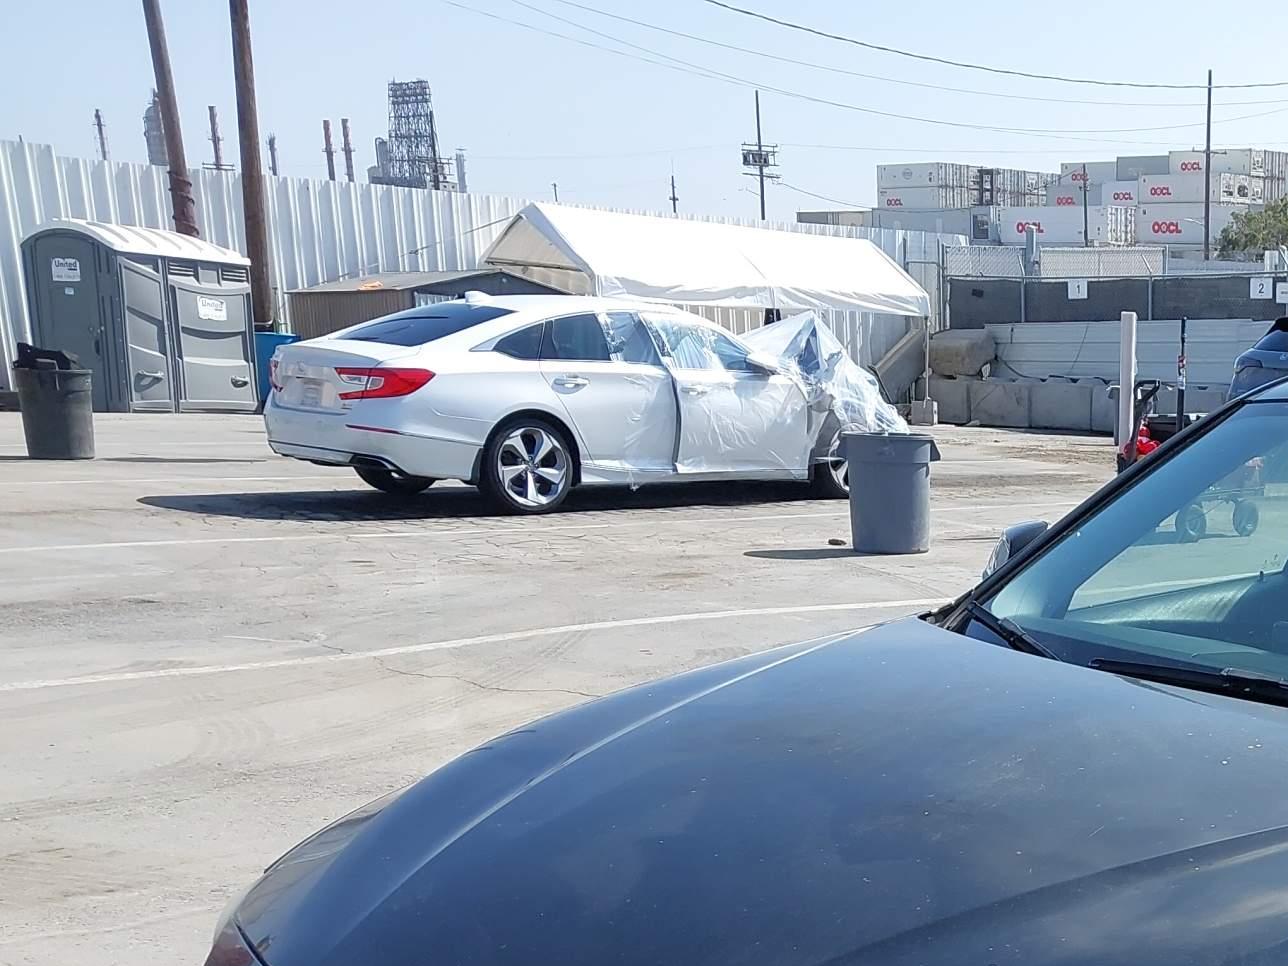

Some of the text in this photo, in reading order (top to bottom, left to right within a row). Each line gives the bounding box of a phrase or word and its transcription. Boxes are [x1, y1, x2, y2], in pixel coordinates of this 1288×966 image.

[1180, 159, 1203, 171] OOCL
[1113, 192, 1134, 201] OOCL
[1150, 186, 1172, 197] OOCL
[1056, 196, 1076, 206] OOCL
[1151, 221, 1182, 235] OOCL
[1258, 283, 1265, 294] 2
